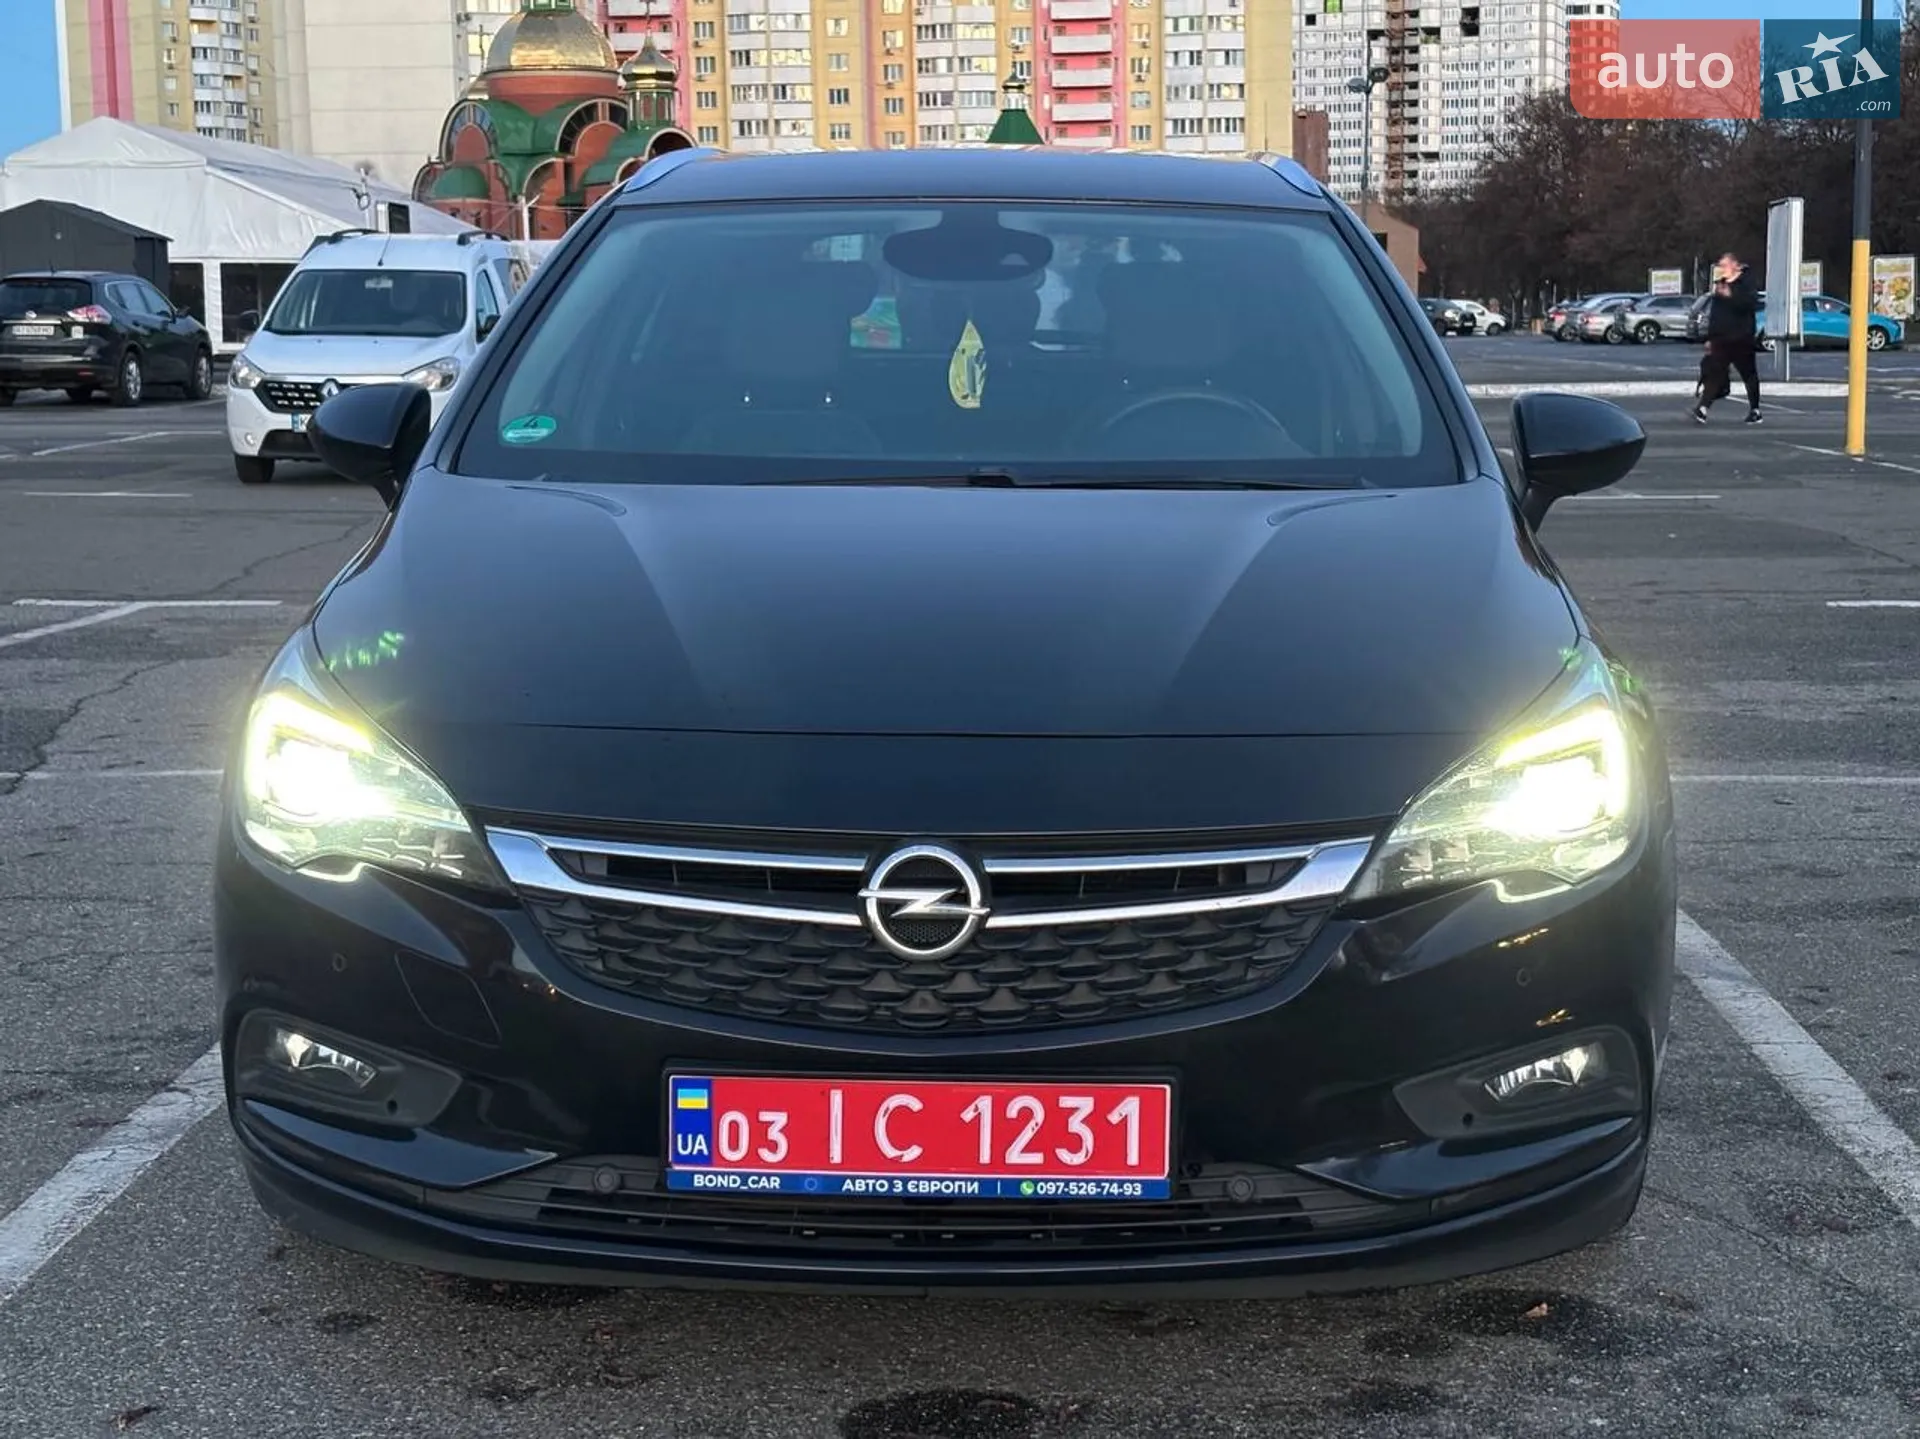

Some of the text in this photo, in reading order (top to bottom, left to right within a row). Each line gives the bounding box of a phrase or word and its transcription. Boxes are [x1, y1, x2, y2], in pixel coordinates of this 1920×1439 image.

[718, 1110, 789, 1163] 03
[960, 1095, 1141, 1166] 1231
[677, 1133, 709, 1155] UA
[693, 1174, 781, 1190] BOND_CAR
[842, 1179, 888, 1193] АВТО
[907, 1180, 979, 1194] ЄВРОПИ
[1036, 1181, 1142, 1196] 097-526-74-93
